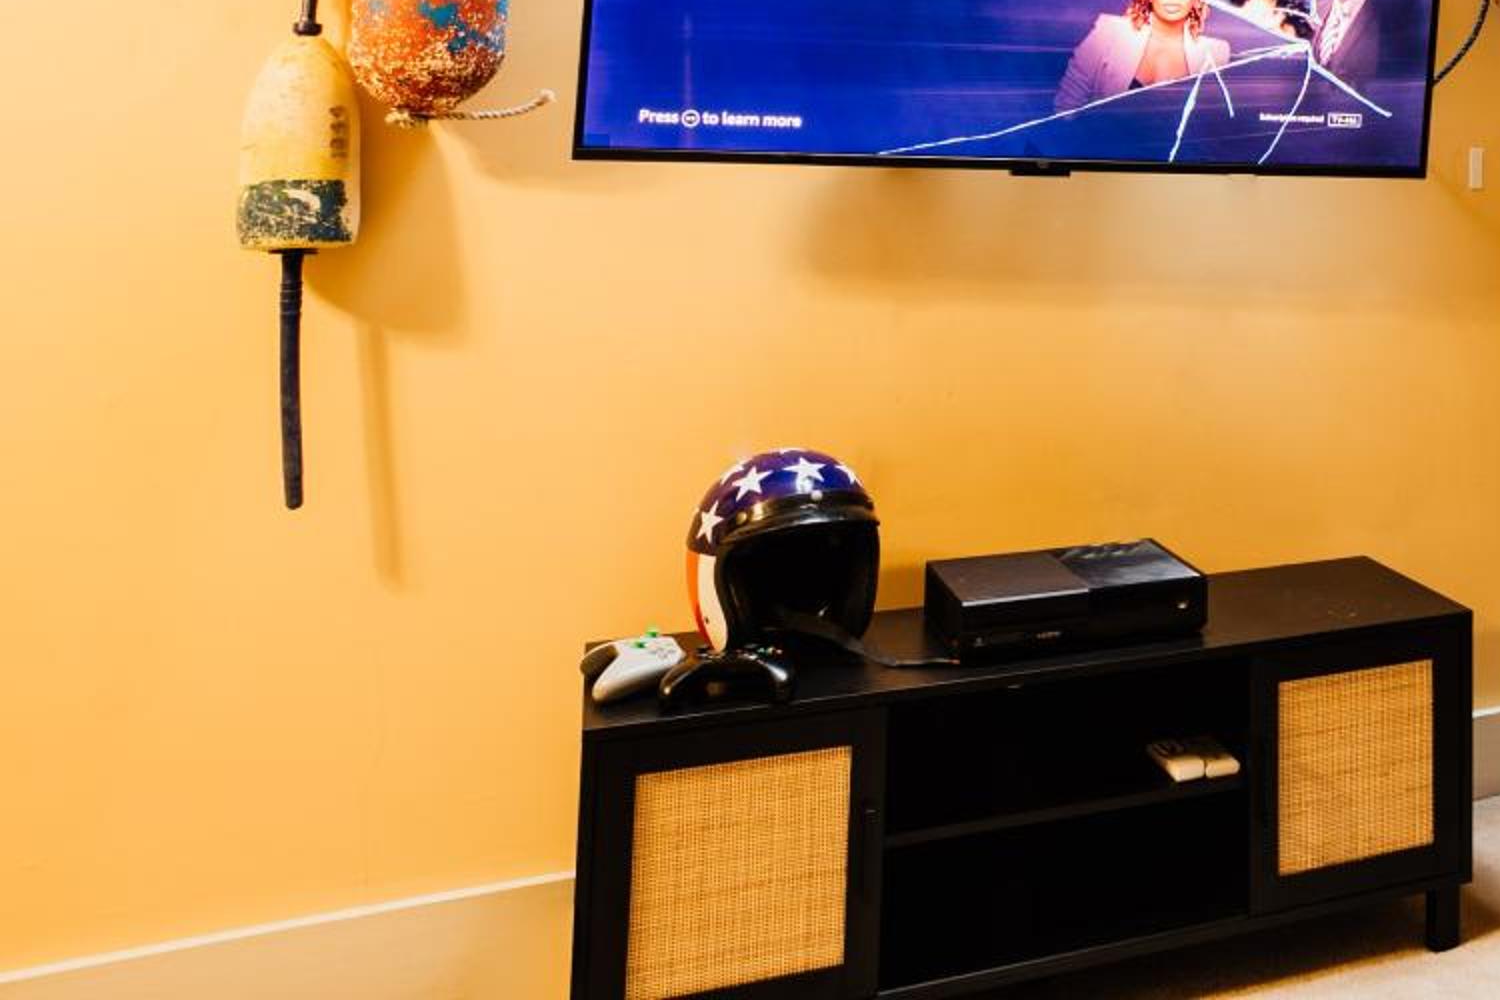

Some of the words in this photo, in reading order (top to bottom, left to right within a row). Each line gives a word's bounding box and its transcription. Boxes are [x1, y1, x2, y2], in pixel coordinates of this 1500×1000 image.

[638, 109, 679, 125] Press
[702, 111, 719, 125] to
[721, 111, 760, 127] learn
[762, 115, 803, 129] more
